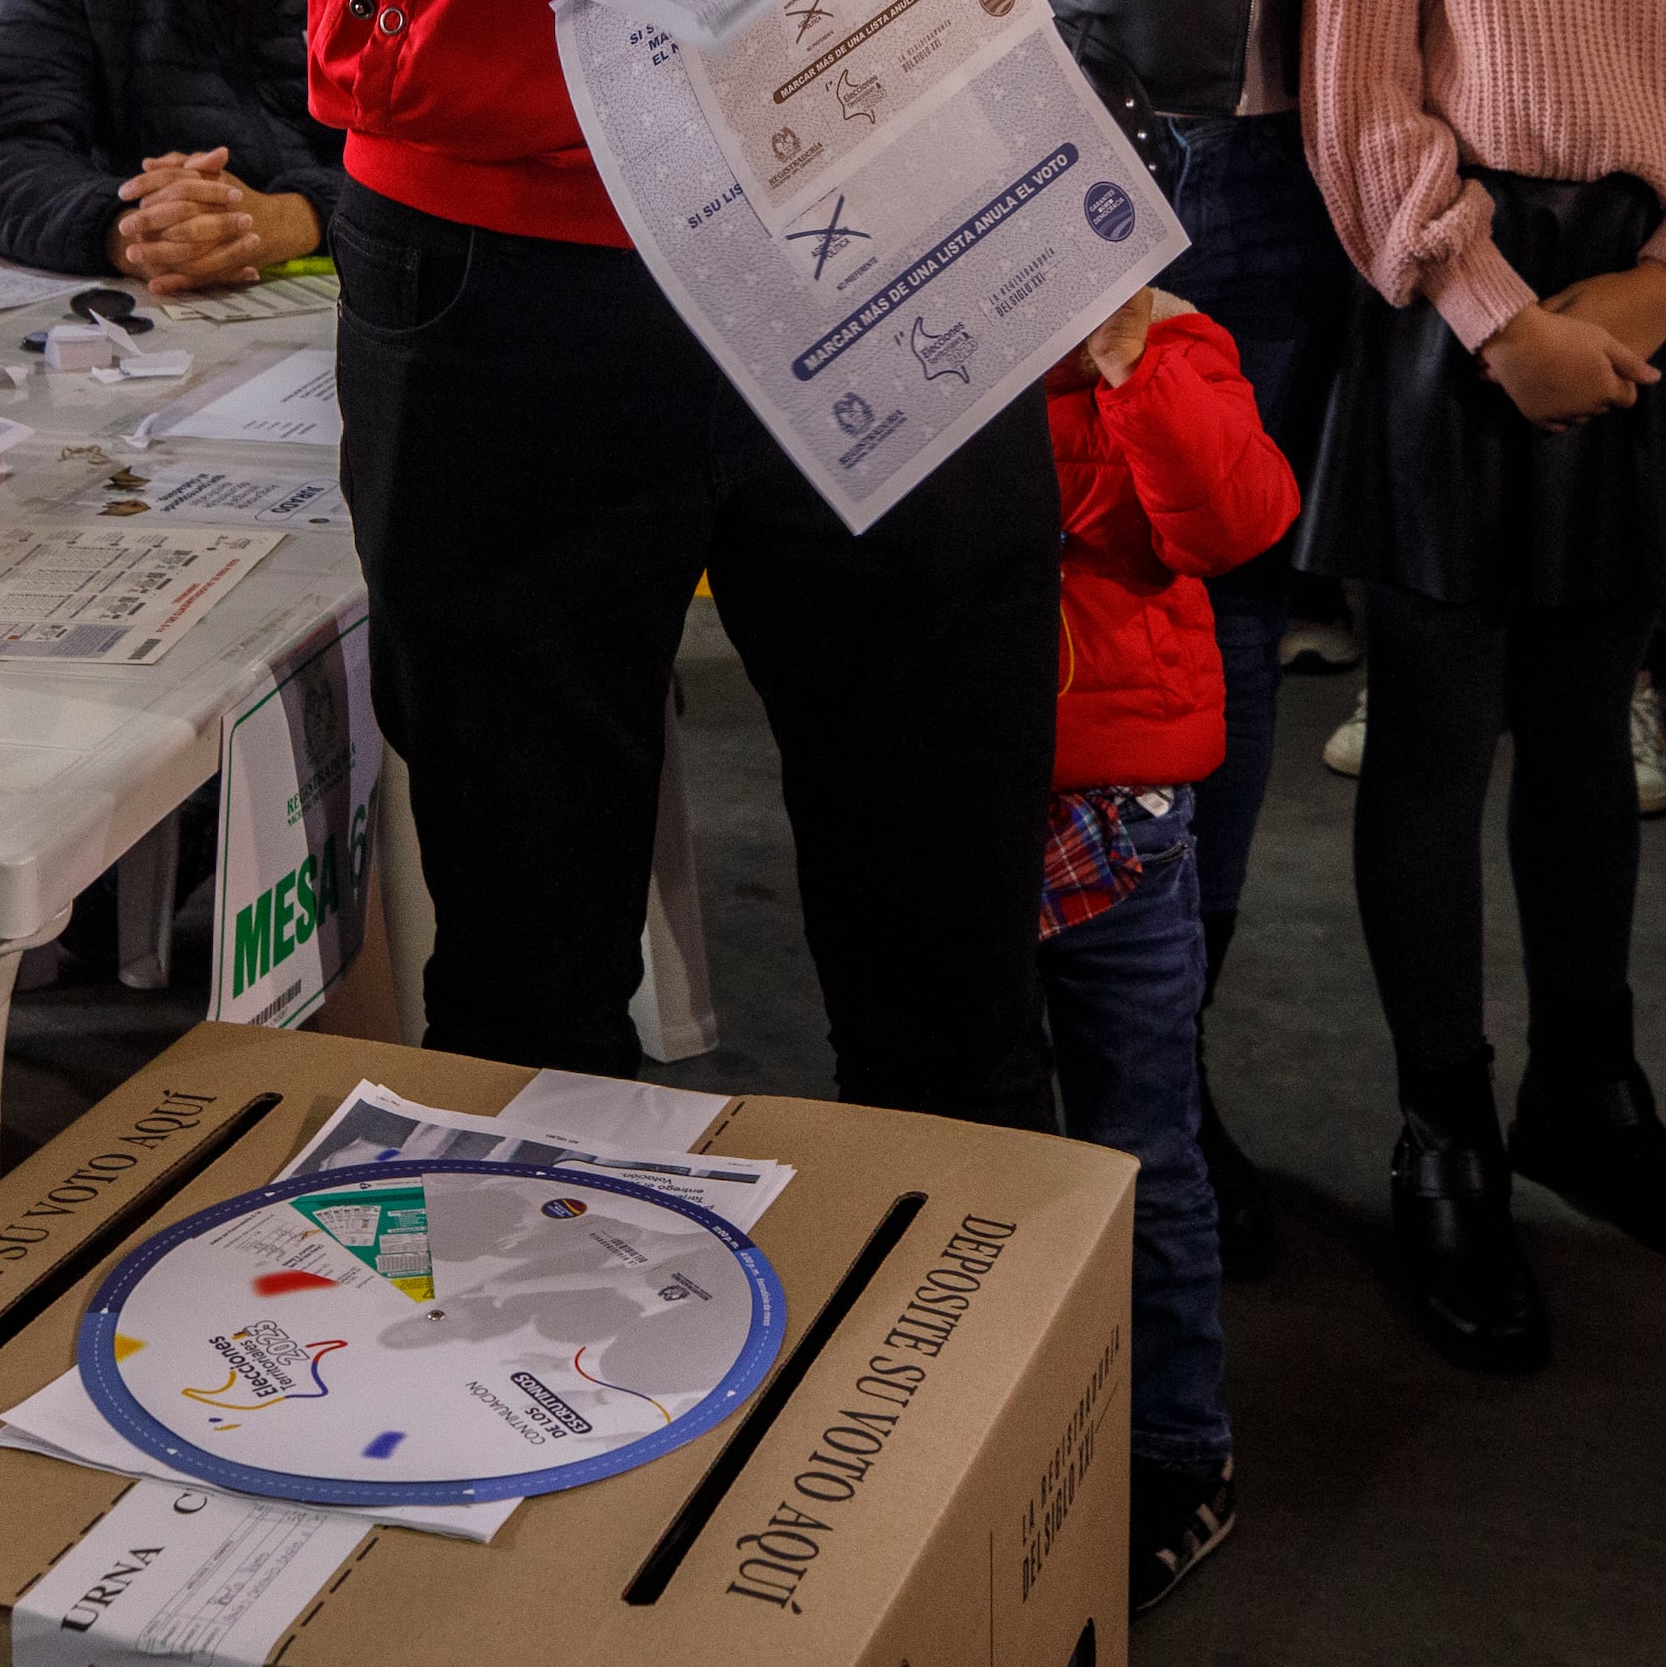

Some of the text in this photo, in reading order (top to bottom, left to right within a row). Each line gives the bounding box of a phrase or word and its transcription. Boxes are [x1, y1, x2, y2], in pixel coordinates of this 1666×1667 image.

[628, 23, 655, 45] SI S
[651, 49, 669, 66] EL
[780, 68, 817, 98] MARCAR
[834, 45, 847, 58] DE
[847, 32, 866, 49] UNA
[865, 13, 890, 35] LISTA
[687, 183, 744, 229] SI SU LIS
[802, 151, 1070, 373] MARCAR MÁS DE UNA LISTA ANULA EL VOTO
[995, 271, 1046, 317] DEL SIGLO XXI
[920, 320, 965, 359] Elecciones
[233, 838, 340, 1001] MESA
[26, 1153, 139, 1218] VOTO
[121, 1089, 217, 1150] AQUÍ
[209, 1335, 278, 1398] Elecciones
[239, 1339, 297, 1391] Territoriales
[465, 1380, 546, 1446] CONTINUACIÓN
[514, 1372, 589, 1434] ESCRUTINIOS
[524, 1403, 568, 1439] DE LOS
[725, 1213, 1017, 1615] DEPOSITE SU VOTO AQUÍ
[60, 1545, 165, 1634] URNA
[1023, 1530, 1042, 1603] DEL
